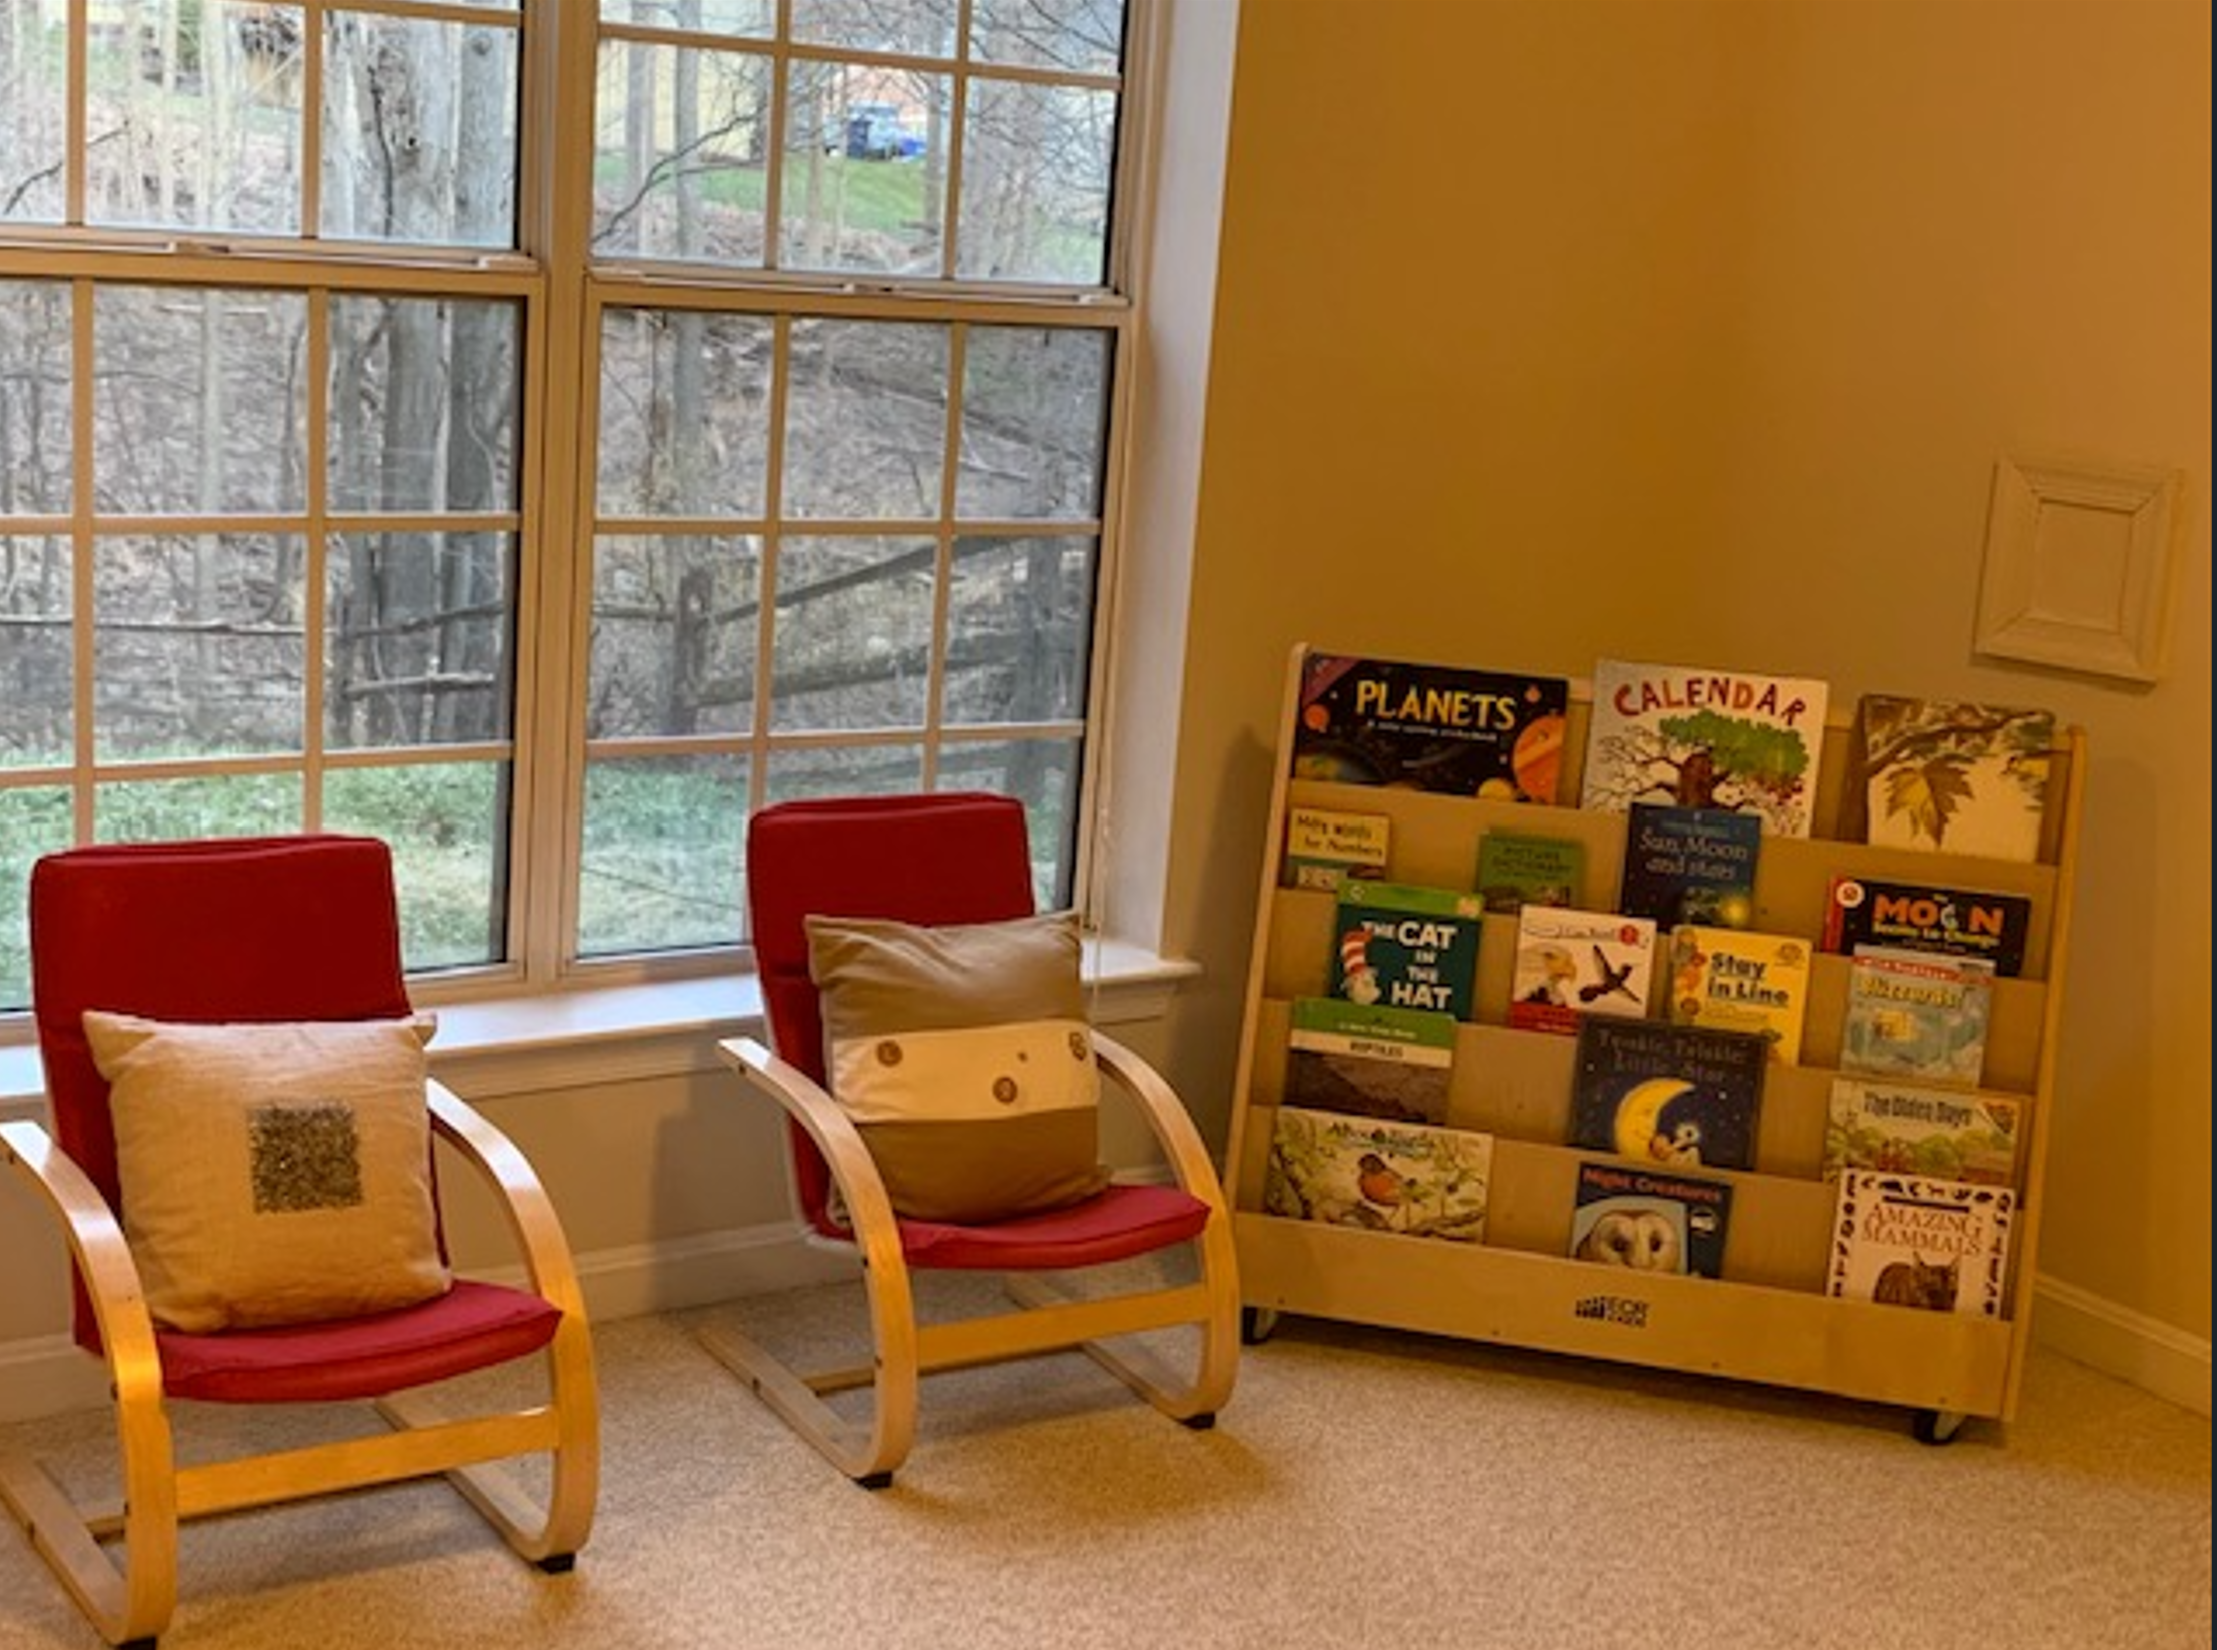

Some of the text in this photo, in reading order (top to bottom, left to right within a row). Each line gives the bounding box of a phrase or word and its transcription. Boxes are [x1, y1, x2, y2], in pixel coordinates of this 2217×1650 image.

[1356, 679, 1516, 731] PLANETS
[1613, 677, 1806, 726] CALENDAR
[1685, 836, 1748, 861] Moon
[1361, 919, 1457, 949] THE CAT
[1414, 949, 1437, 964] IN
[1711, 951, 1768, 981] Stay
[1406, 965, 1438, 984] THE
[1391, 980, 1452, 1010] HAT
[1707, 976, 1790, 1005] in Line
[1350, 1040, 1404, 1058] REPTILES
[1864, 1092, 1890, 1115] The
[1891, 1094, 1934, 1121] Olden
[1936, 1100, 1973, 1128] Days
[1582, 1168, 1722, 1202] Night Creatures
[1862, 1218, 1982, 1255] MAMMALS
[1868, 1203, 1983, 1241] AMAZING
